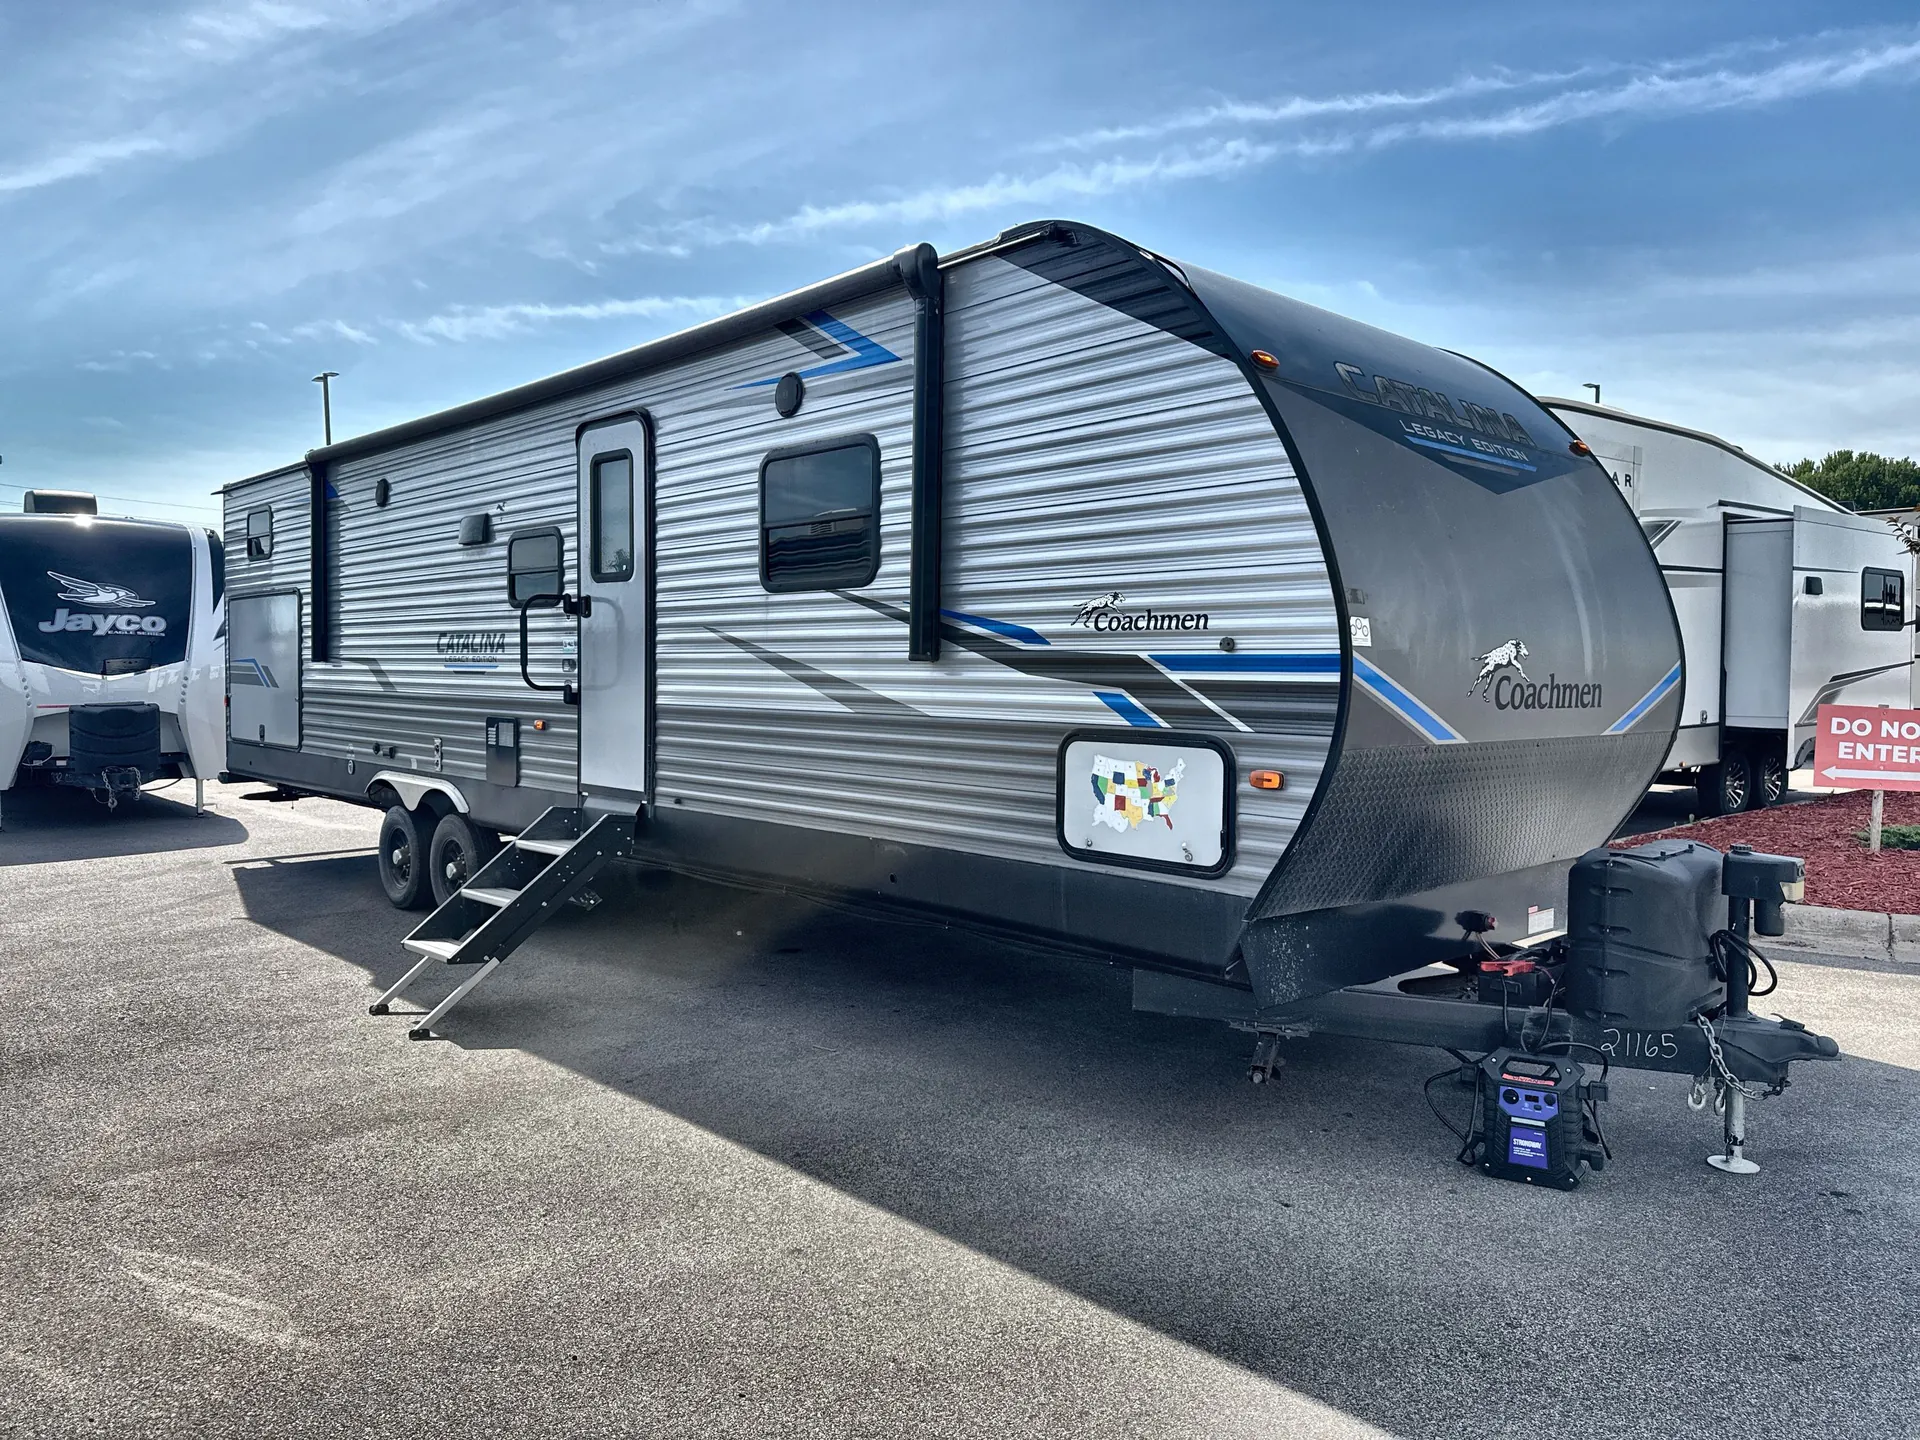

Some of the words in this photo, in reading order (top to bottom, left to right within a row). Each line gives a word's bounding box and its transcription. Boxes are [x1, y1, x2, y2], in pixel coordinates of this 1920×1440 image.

[1333, 360, 1537, 447] CATALINA
[1399, 419, 1466, 446] LEGACY
[1470, 438, 1529, 462] EDITION
[38, 608, 167, 636] Jayco
[1094, 609, 1209, 632] Coachmen
[436, 632, 506, 653] CATALINA
[444, 655, 469, 663] LEGACY
[471, 655, 498, 663] EDITION
[1494, 673, 1602, 711] Coachmen
[1830, 717, 1873, 737] DO
[1838, 741, 1920, 764] ENTER
[1600, 1028, 1678, 1059] 21165
